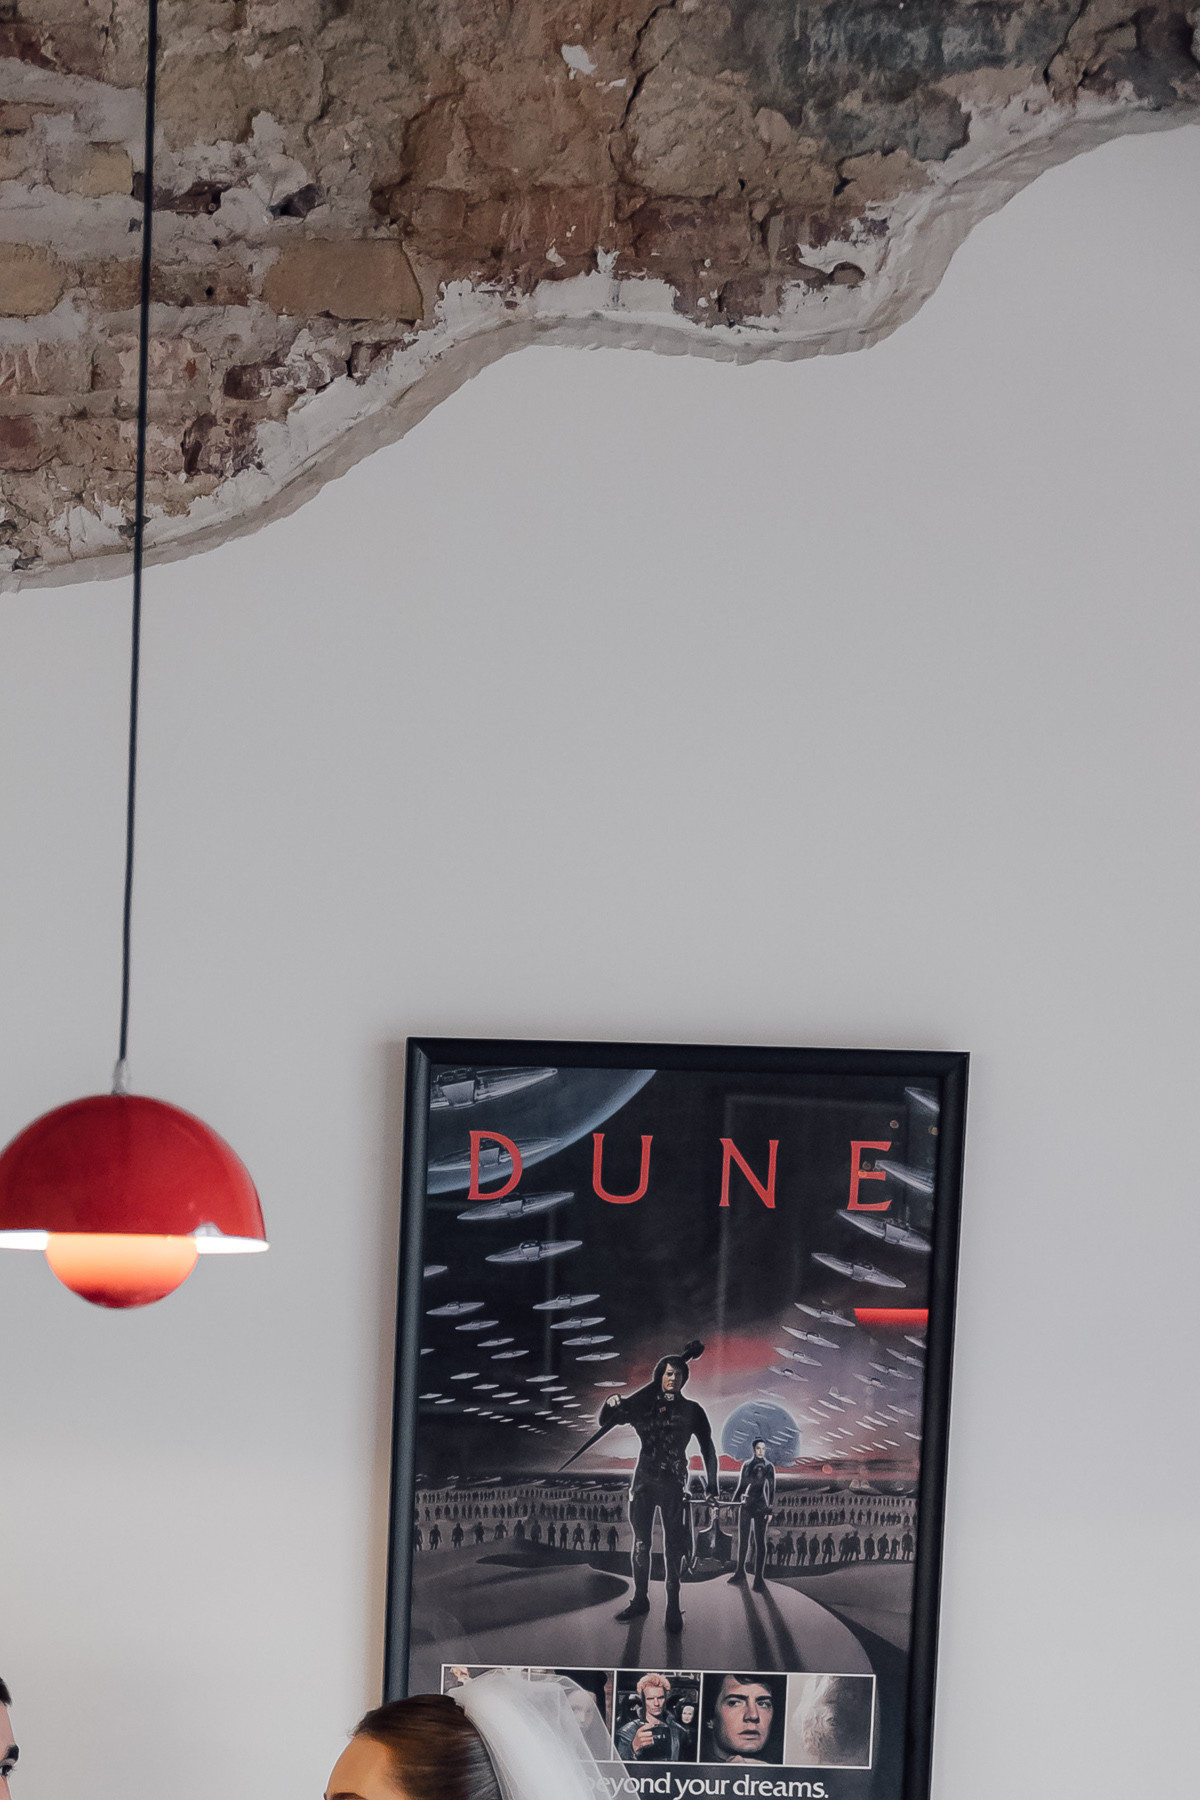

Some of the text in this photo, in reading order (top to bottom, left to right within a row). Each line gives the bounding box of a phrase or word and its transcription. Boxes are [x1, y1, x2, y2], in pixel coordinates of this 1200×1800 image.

[467, 1130, 893, 1212] DUNE
[673, 1780, 730, 1800] your
[733, 1774, 829, 1799] dreams.
